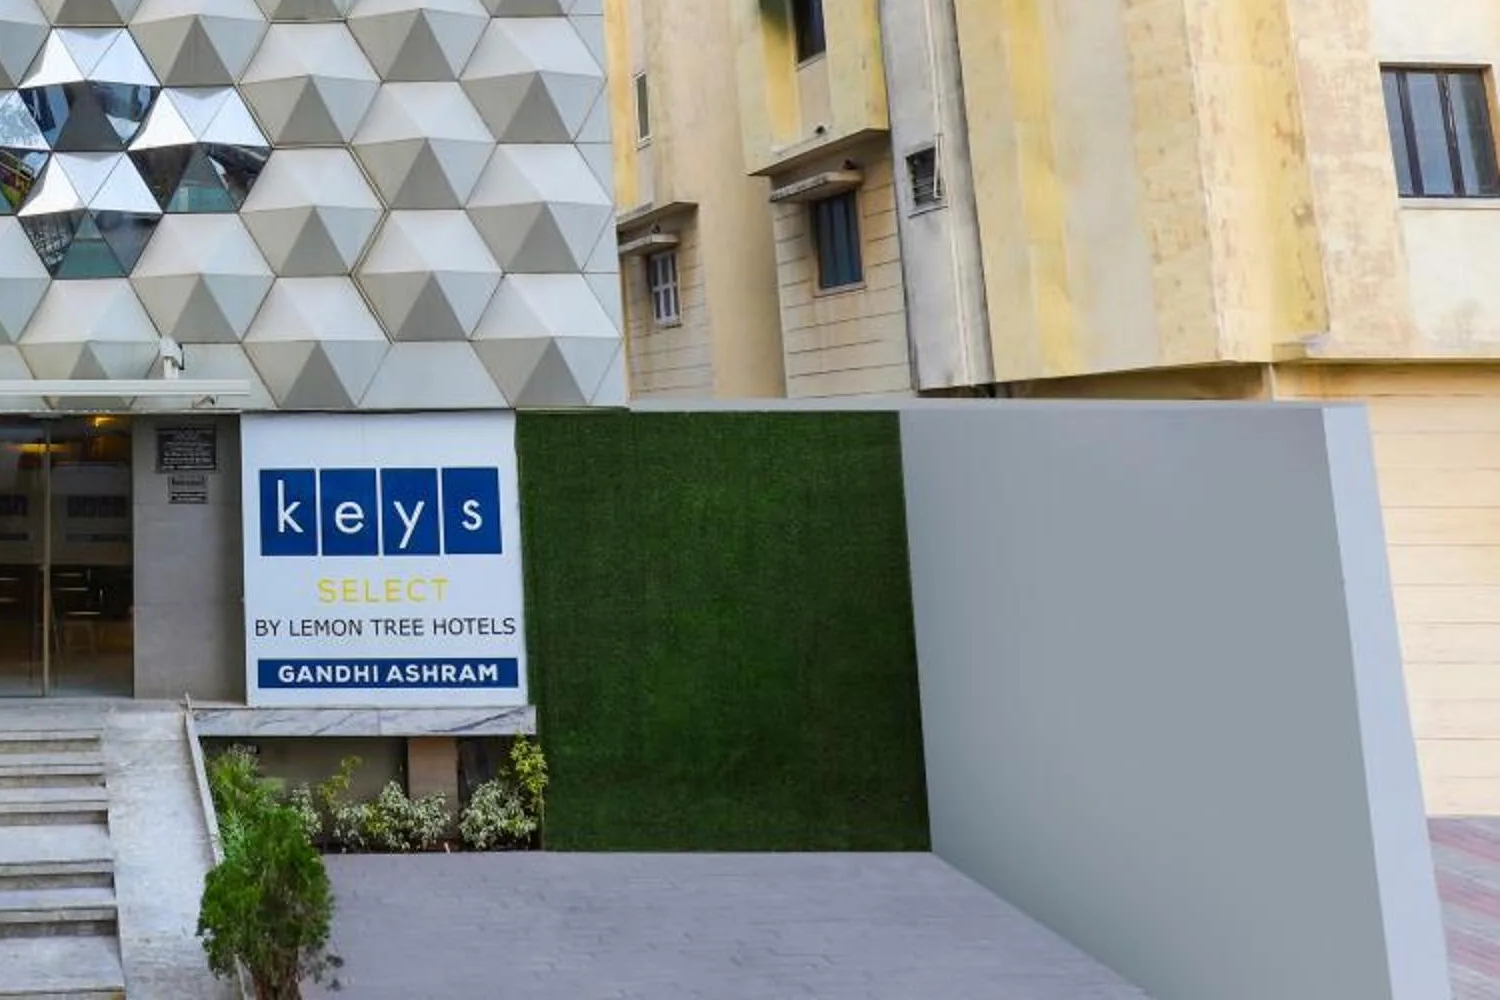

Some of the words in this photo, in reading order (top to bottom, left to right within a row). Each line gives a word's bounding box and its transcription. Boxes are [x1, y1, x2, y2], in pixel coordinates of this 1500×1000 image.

[277, 479, 484, 549] keys
[316, 578, 449, 604] SELECT
[255, 619, 281, 637] BY
[289, 619, 363, 637] LEMON
[370, 618, 425, 637] TREE
[433, 617, 516, 636] HOTELS
[278, 664, 379, 684] GANDHI
[386, 663, 499, 683] ASHRAM
